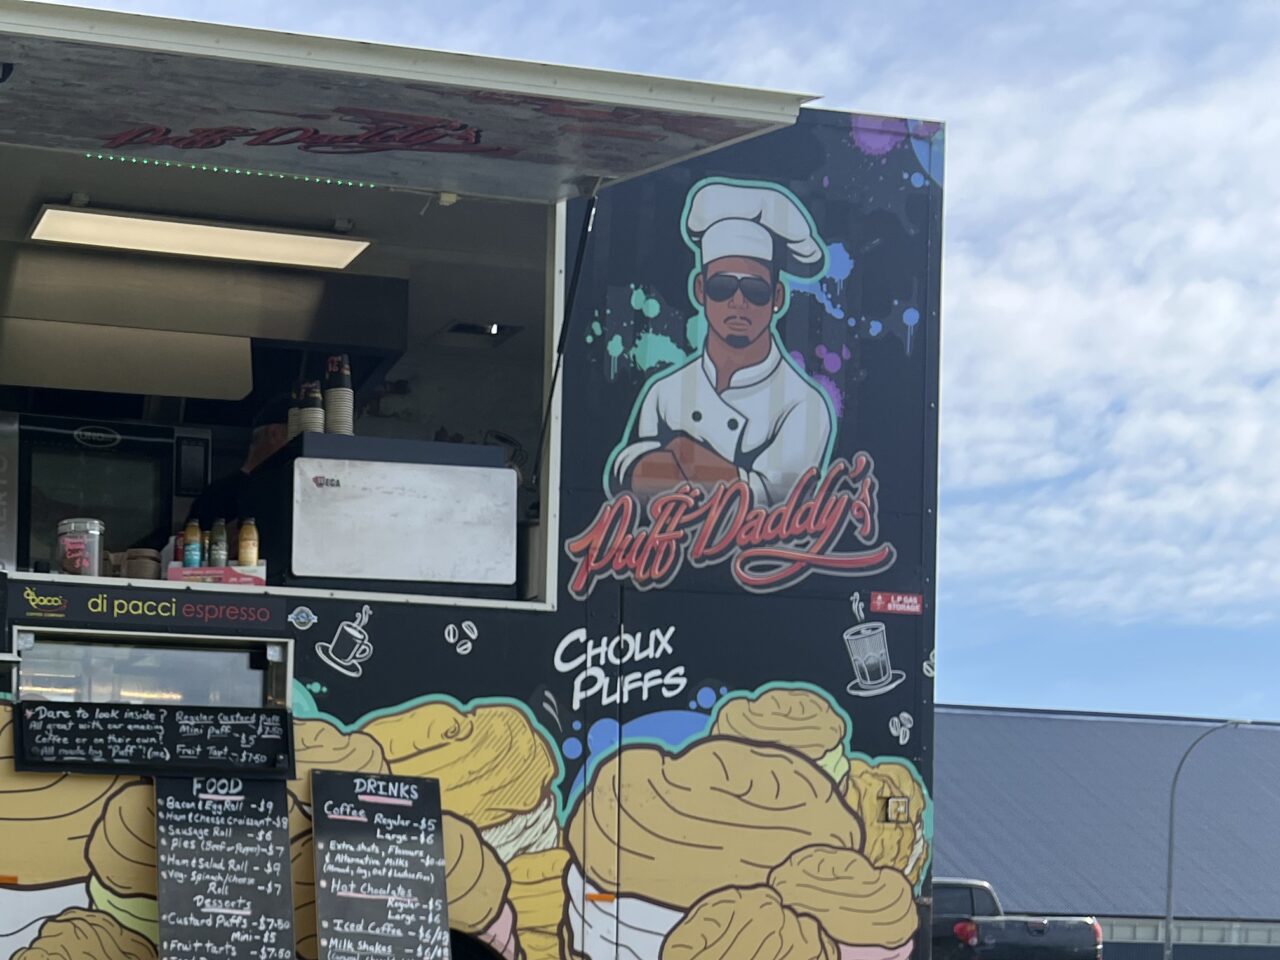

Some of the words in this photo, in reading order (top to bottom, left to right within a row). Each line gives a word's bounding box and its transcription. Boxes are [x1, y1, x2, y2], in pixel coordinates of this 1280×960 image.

[567, 483, 703, 593] Puff
[690, 450, 893, 587] Daddy's
[87, 594, 107, 613] di
[113, 598, 177, 617] pacci
[182, 602, 270, 623] espresso
[554, 625, 676, 673] CHOUX
[572, 665, 687, 711] PUFFS
[35, 706, 71, 720] Dare
[75, 707, 90, 719] to
[94, 708, 120, 720] look
[175, 710, 215, 725] Regular
[217, 712, 256, 723] Custard
[29, 720, 43, 730] All
[46, 720, 75, 735] great
[78, 720, 104, 731] with
[107, 723, 125, 731] our
[127, 722, 165, 735] amazing
[179, 724, 204, 735] Mini
[35, 734, 70, 745] Coffee
[107, 733, 132, 744] their
[40, 745, 55, 757] All
[88, 745, 104, 758] by
[175, 743, 202, 756] Fruit
[206, 745, 228, 756] Tart
[192, 777, 243, 796] FOOD
[353, 777, 419, 800] DRINKS
[165, 796, 196, 810] Bacon
[204, 800, 223, 815] Egg
[223, 800, 244, 812] Roll
[323, 800, 367, 818] Coffee
[165, 811, 186, 822] Ham
[193, 812, 225, 825] Cheese
[226, 815, 273, 827] Croissant
[373, 812, 411, 830] Regular
[167, 824, 209, 840] Sausage
[212, 826, 232, 838] Roll
[376, 827, 408, 844] Large
[170, 837, 196, 851] Pies
[328, 839, 355, 852] Extra
[166, 853, 190, 868] Ham
[197, 856, 225, 871] Salad
[227, 858, 248, 873] Roll
[334, 853, 381, 867] Alternative
[384, 856, 409, 869] Milks
[206, 881, 229, 896] Roll
[330, 877, 356, 893] Hot
[359, 881, 414, 898] Chocolates
[193, 894, 252, 910] Desserts
[386, 896, 420, 913] Regular
[167, 911, 213, 927] Custard
[215, 914, 248, 929] Puffs
[387, 909, 417, 926] Large
[332, 917, 365, 932] Iced
[367, 920, 404, 937] Coffee
[230, 930, 253, 943] Mini
[328, 936, 354, 951] Milk
[356, 939, 393, 954] Shakes
[169, 940, 203, 951] Fruit
[204, 940, 238, 957] tarts
